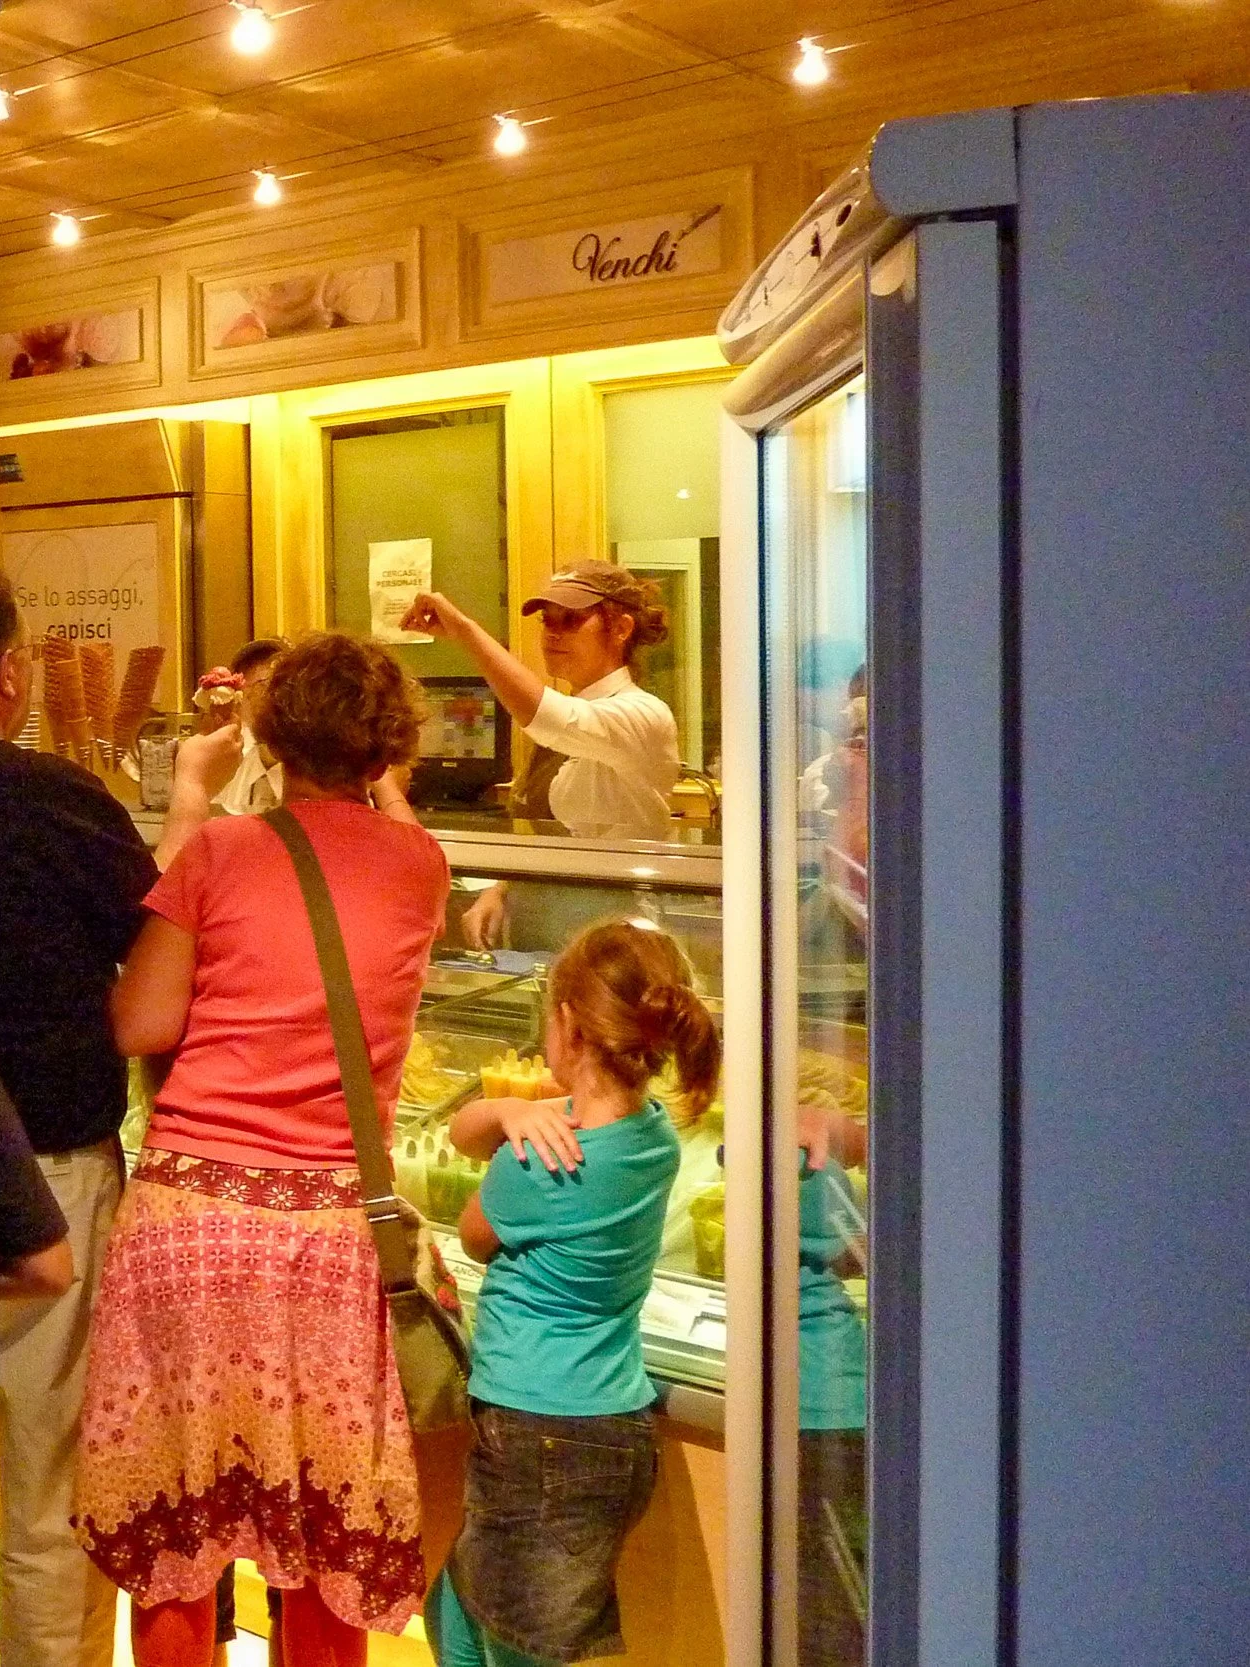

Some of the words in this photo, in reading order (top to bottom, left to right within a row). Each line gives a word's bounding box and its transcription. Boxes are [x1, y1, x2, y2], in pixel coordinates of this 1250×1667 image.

[572, 230, 678, 281] Venchi
[17, 586, 38, 608] Se
[44, 585, 60, 607] lo
[66, 581, 143, 611] assaggi,
[46, 616, 112, 641] capisci
